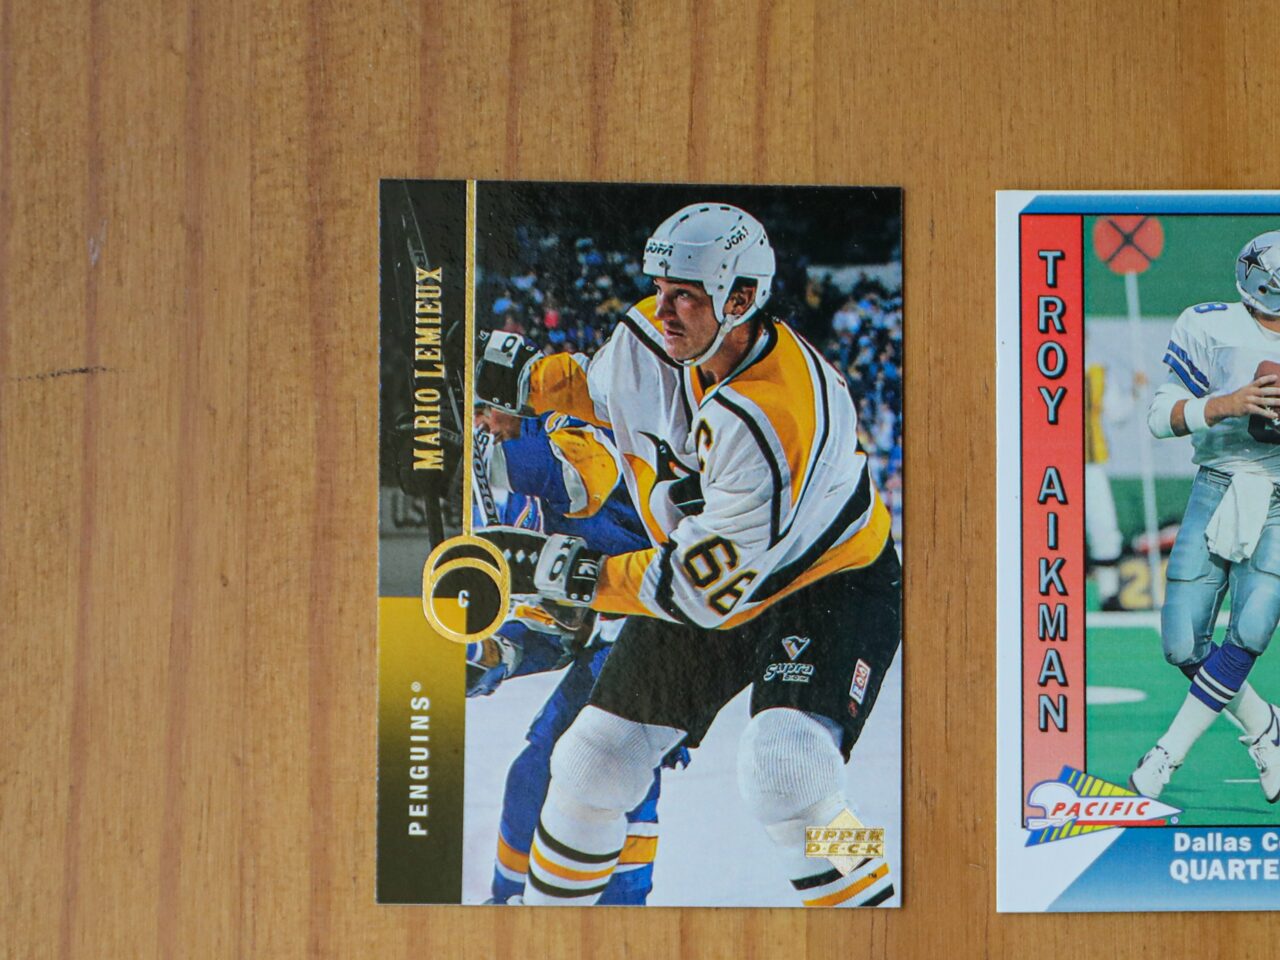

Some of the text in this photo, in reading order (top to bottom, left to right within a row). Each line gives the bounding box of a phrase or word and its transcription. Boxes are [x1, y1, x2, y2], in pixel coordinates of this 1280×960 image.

[415, 266, 446, 380] LEMIEUX
[413, 388, 444, 471] MARIO
[1036, 249, 1069, 733] TROY AIKMAN
[457, 589, 471, 609] C
[683, 534, 758, 618] 66
[1050, 802, 1150, 816] PACIFIC
[806, 830, 883, 841] UPPER
[1174, 832, 1252, 852] Dallas
